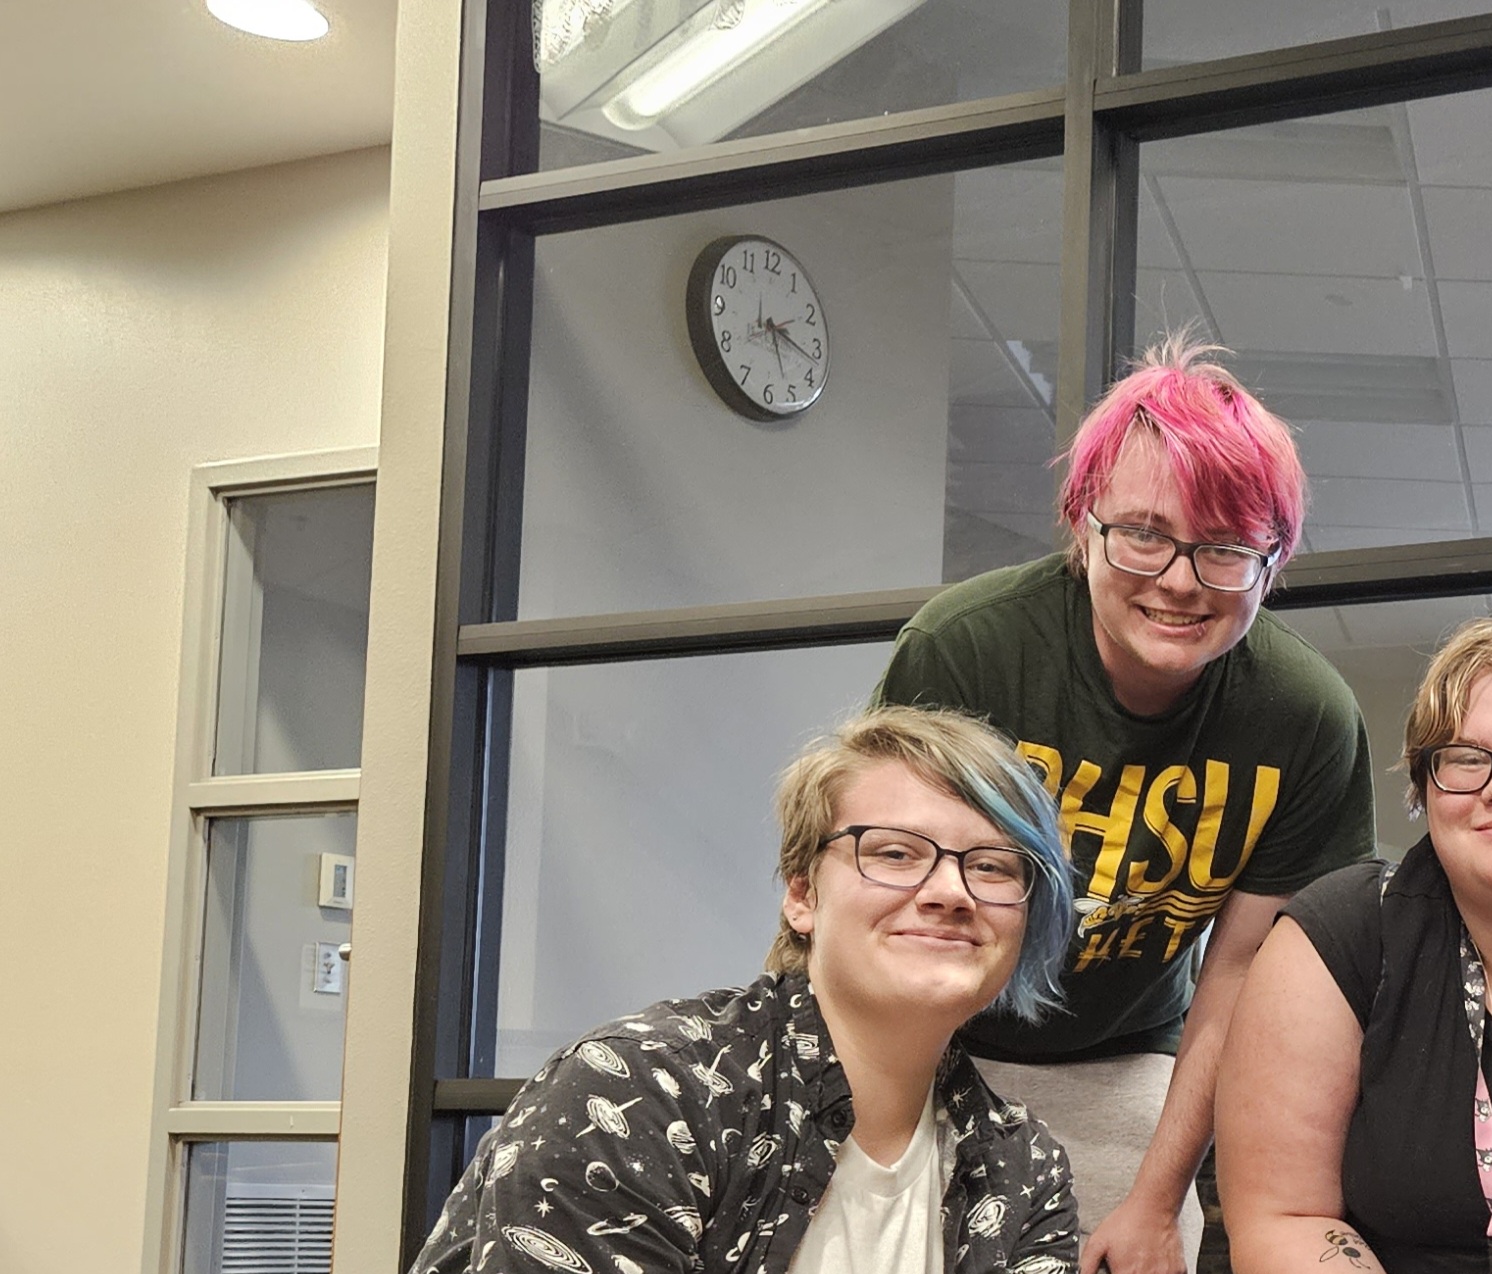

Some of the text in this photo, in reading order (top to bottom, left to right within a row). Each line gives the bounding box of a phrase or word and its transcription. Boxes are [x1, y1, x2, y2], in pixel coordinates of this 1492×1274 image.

[742, 249, 755, 274] 11
[763, 249, 782, 276] 12
[719, 264, 737, 289] 10
[790, 272, 797, 294] 1
[713, 295, 726, 316] 9
[806, 303, 816, 326] 2
[720, 330, 732, 353] 8
[812, 338, 823, 360] 3
[739, 365, 752, 387] 7
[804, 367, 816, 389] 4
[763, 383, 774, 405] 6
[786, 385, 797, 403] 5
